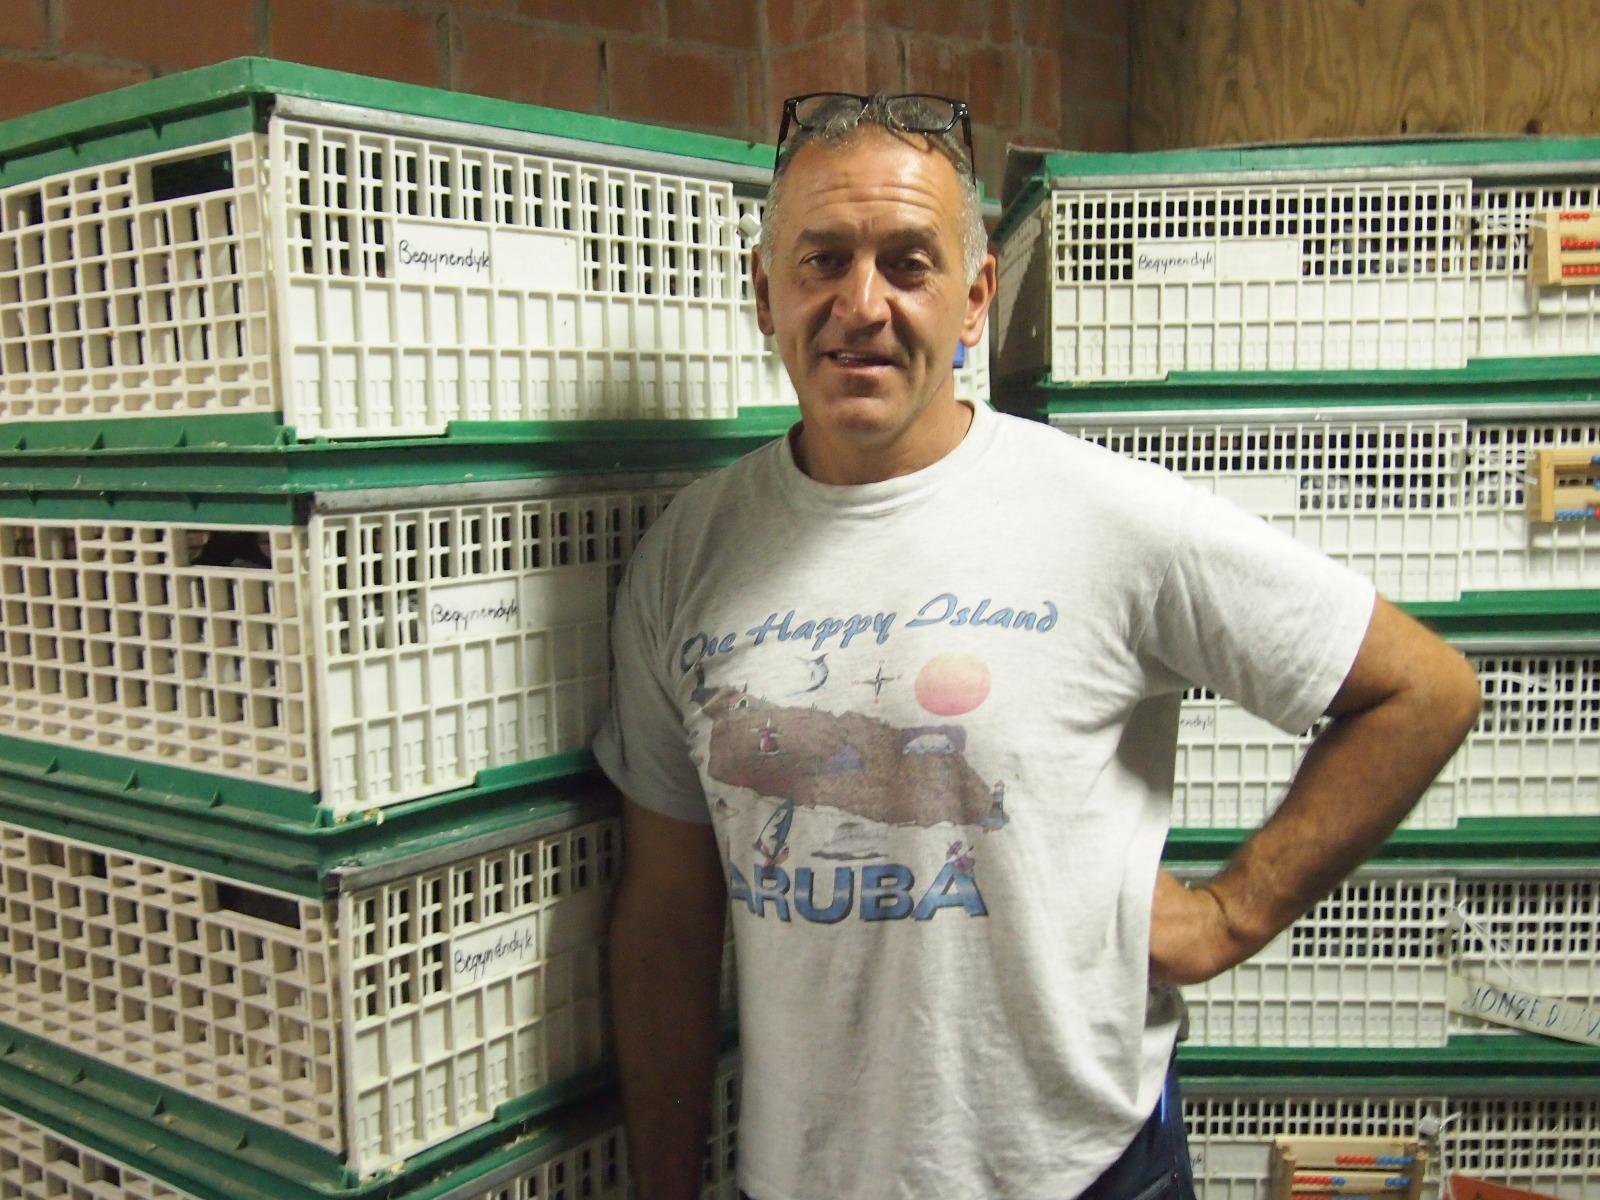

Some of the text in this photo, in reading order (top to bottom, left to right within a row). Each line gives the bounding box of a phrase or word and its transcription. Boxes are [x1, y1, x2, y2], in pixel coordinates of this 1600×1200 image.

[745, 609, 897, 651] Happy
[905, 592, 1059, 634] Island
[729, 859, 989, 924] ARUBA
